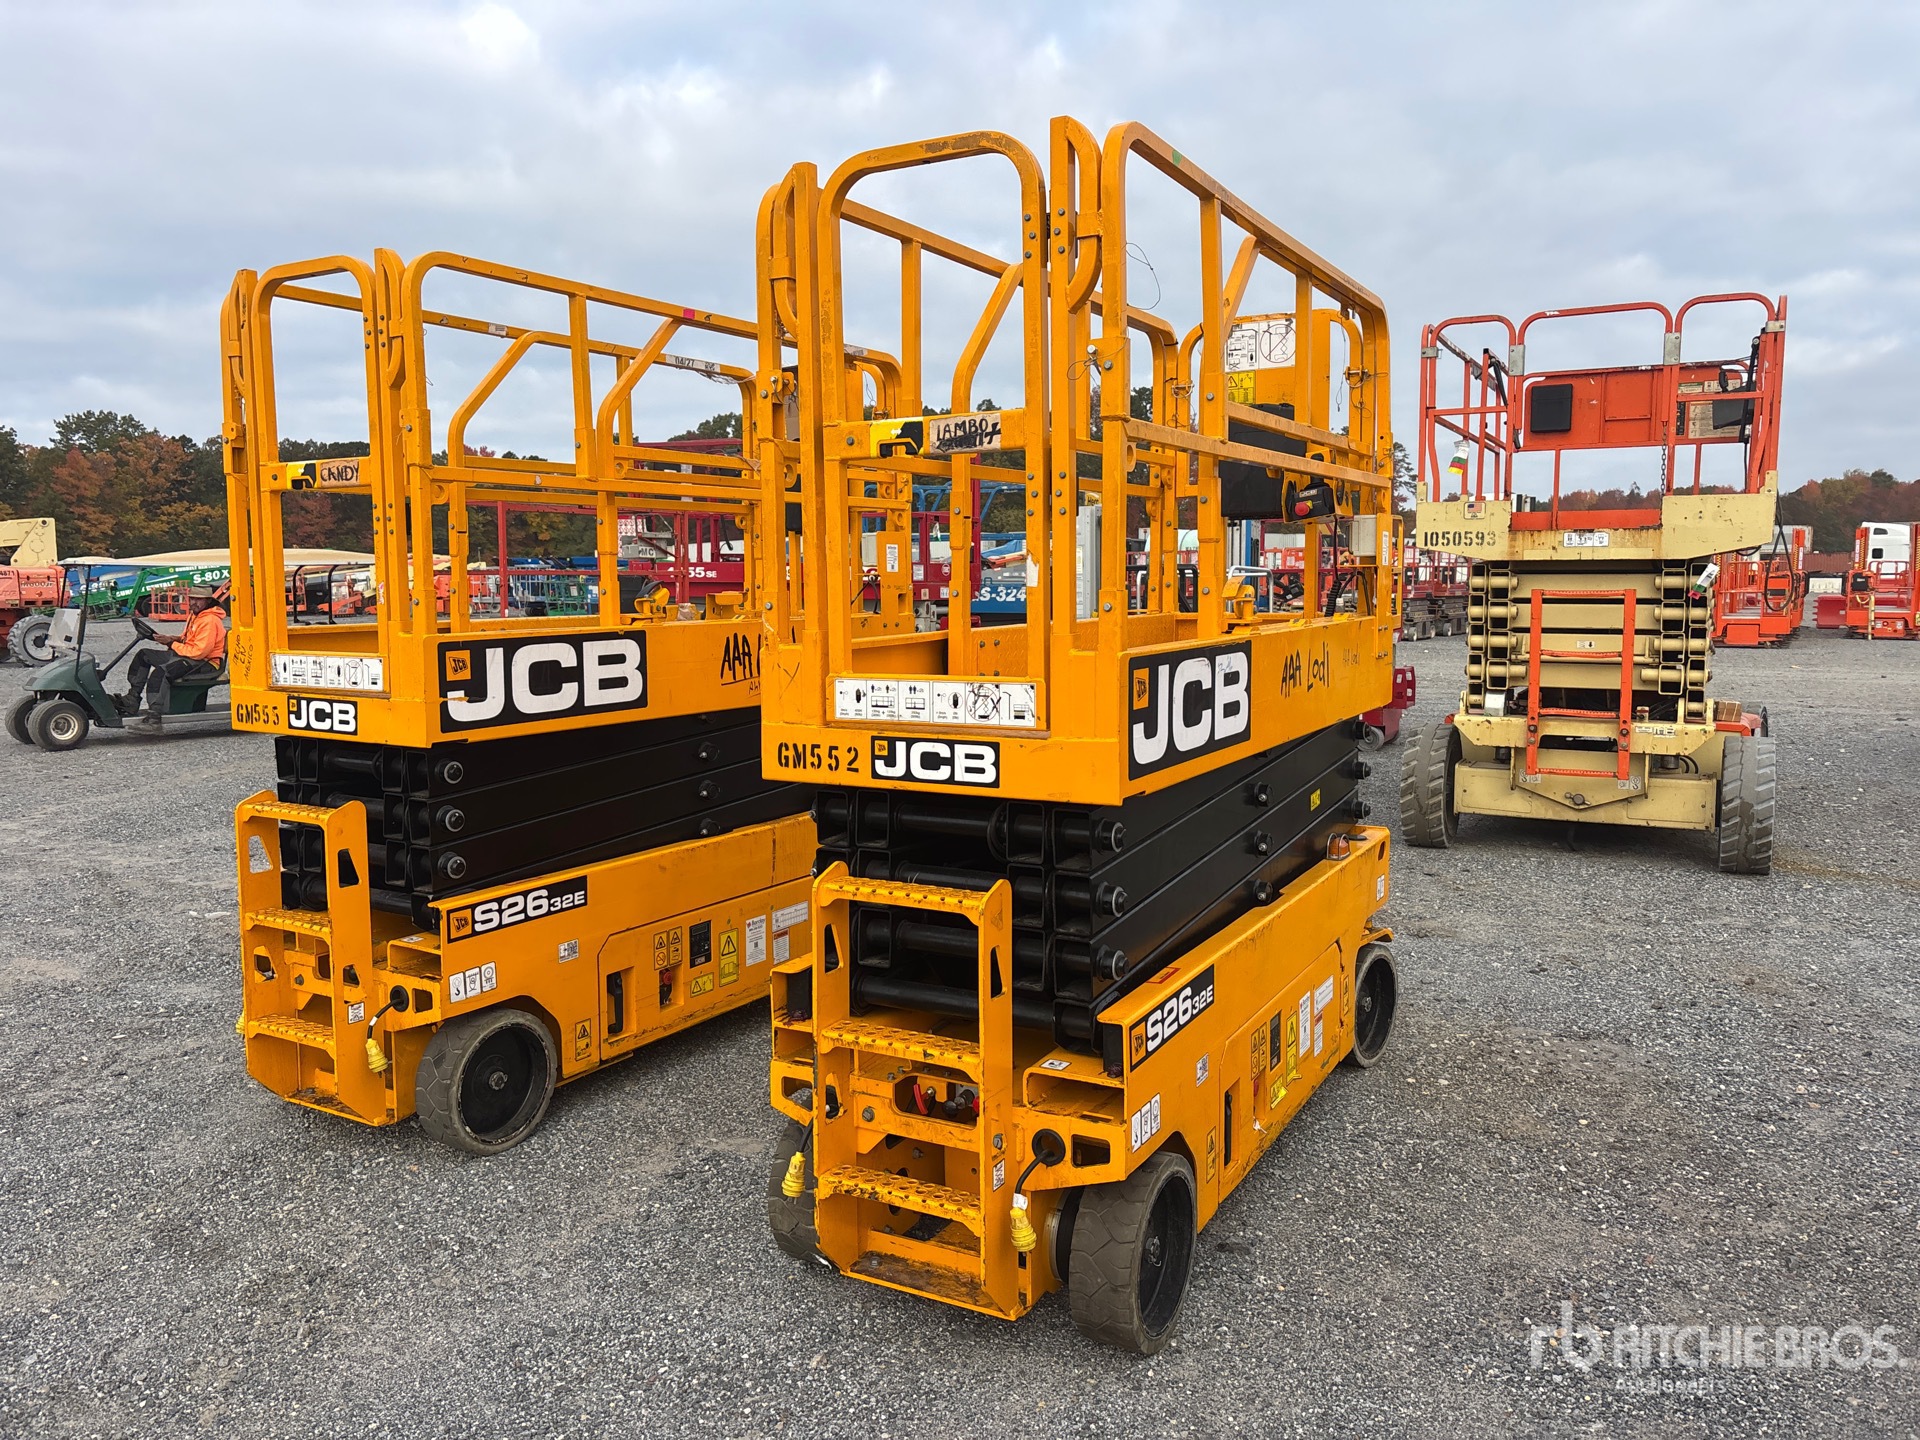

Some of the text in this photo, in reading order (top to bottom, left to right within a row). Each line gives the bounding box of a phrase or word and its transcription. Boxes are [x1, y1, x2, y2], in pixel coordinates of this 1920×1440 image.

[936, 418, 989, 442] LAMBO
[320, 460, 360, 482] CANDY
[1423, 531, 1497, 547] 1050593
[244, 644, 254, 681] MEXICO
[452, 658, 467, 673] JCB
[720, 632, 754, 682] AAA
[1280, 641, 1331, 699] AAA Lodi
[447, 638, 644, 723] JCB
[236, 703, 281, 726] GM555
[289, 699, 357, 733] JCB
[1132, 651, 1250, 766] JCB
[777, 741, 860, 773] GM552
[874, 740, 998, 784] JCB
[453, 916, 469, 932] JCB
